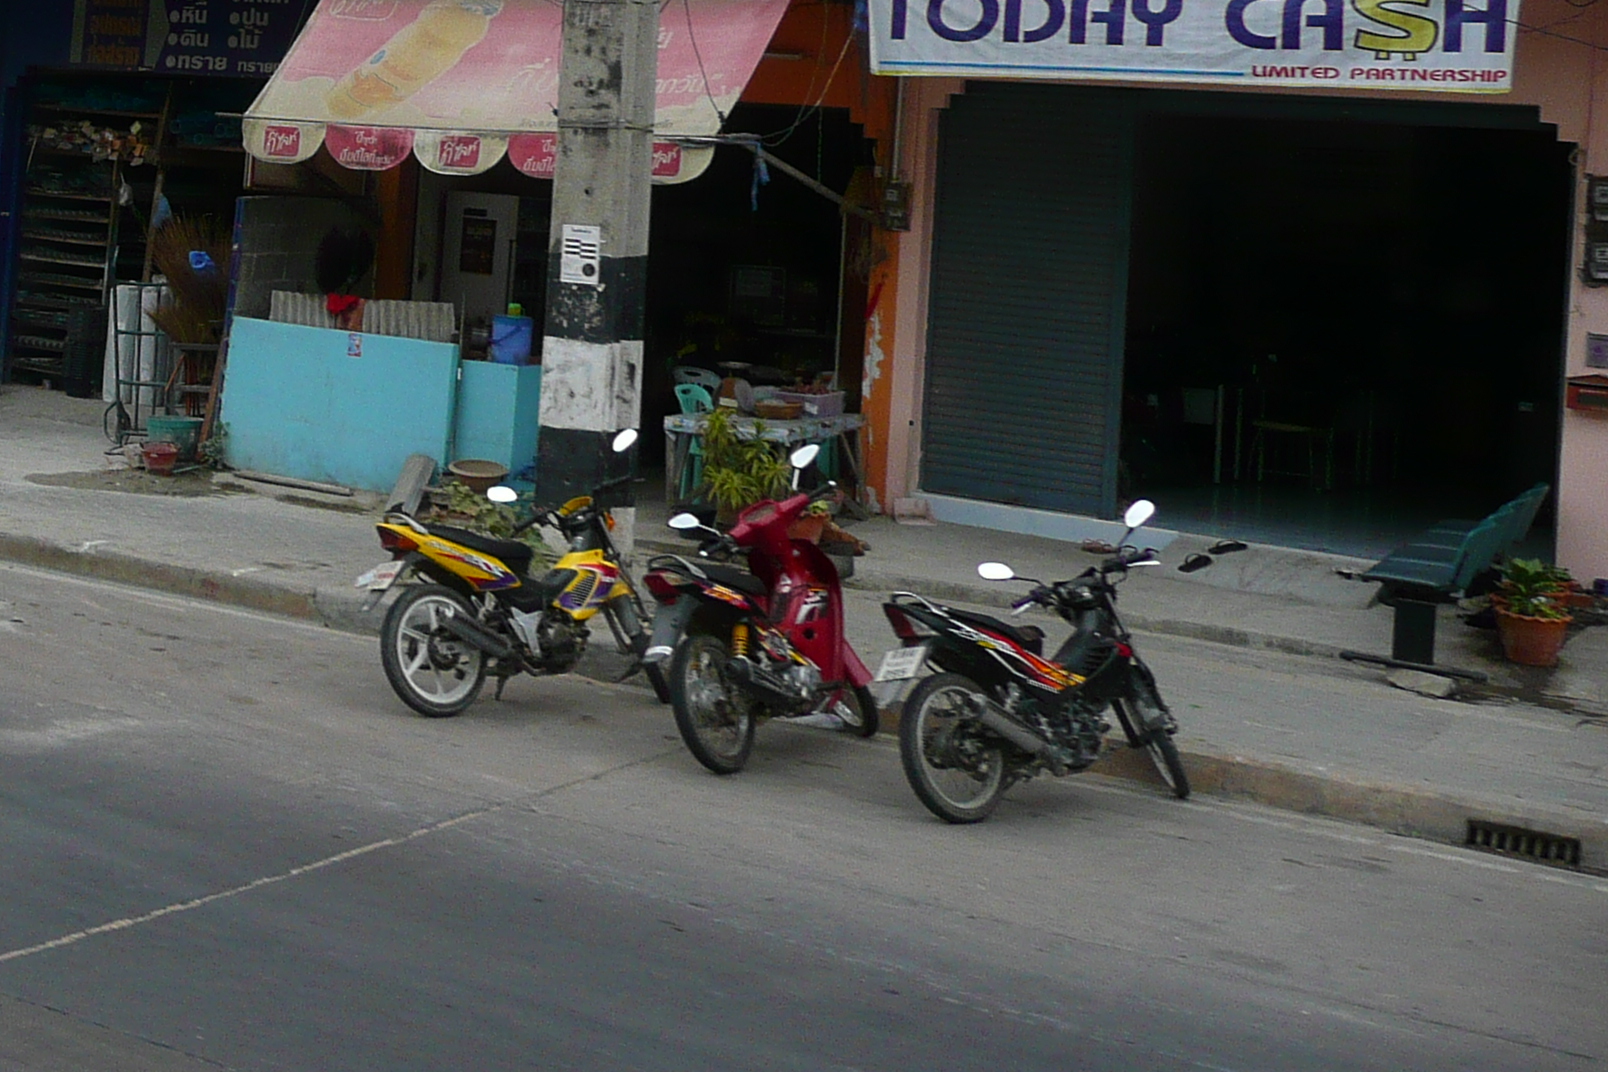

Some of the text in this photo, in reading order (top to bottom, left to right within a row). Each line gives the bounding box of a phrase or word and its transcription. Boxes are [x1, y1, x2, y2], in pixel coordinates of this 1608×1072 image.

[241, 7, 269, 29] ปูน
[180, 29, 209, 47] ดิน
[238, 28, 263, 49] ไม้
[177, 54, 281, 74] ทราย ทราย
[1251, 64, 1508, 83] LIMITED PARTNERSHIP
